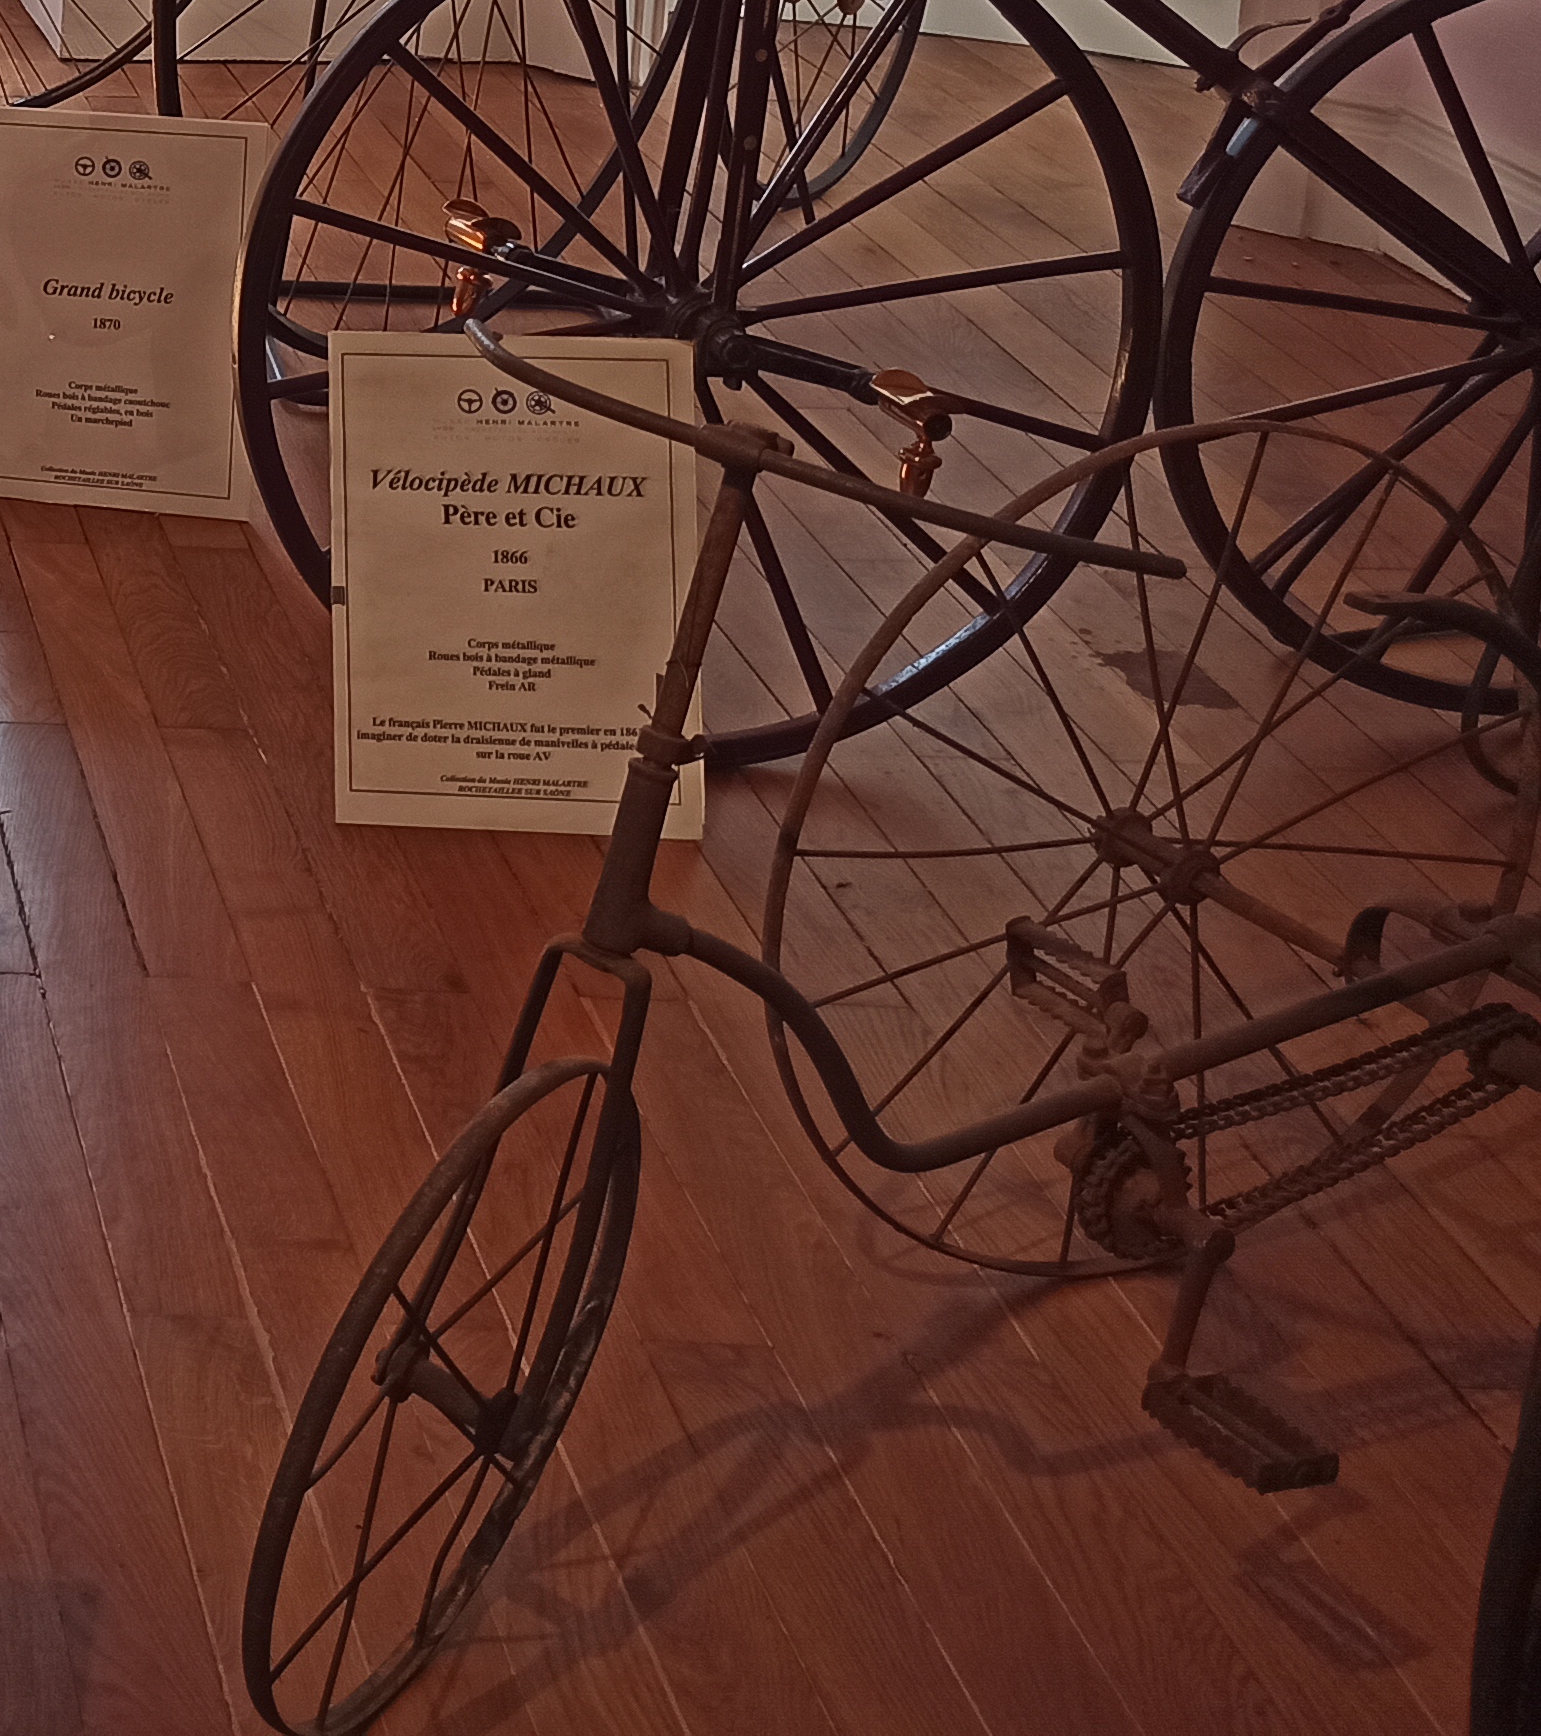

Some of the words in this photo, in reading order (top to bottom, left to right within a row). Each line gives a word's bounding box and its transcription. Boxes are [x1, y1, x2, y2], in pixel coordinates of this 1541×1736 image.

[42, 278, 104, 299] Grand
[107, 282, 173, 306] bicycle
[93, 317, 120, 330] 1870
[70, 413, 82, 422] Un
[517, 419, 579, 427] MALARTRE
[371, 468, 498, 497] Vélocipède
[505, 472, 647, 497] MICHAUX
[441, 503, 497, 526] Père
[504, 508, 527, 527] et
[534, 506, 575, 528] Cie
[493, 549, 527, 564] 1866
[483, 577, 537, 593] PARIS
[467, 637, 499, 651] Corps
[501, 639, 555, 653] métallique
[428, 650, 460, 661] Roues
[462, 651, 483, 662] bois
[485, 652, 492, 662] à
[494, 652, 538, 666] bandage
[540, 655, 595, 668] métallique
[472, 665, 511, 676] Pédales
[513, 668, 519, 677] à
[521, 663, 551, 679] gland
[488, 680, 515, 691] Frein
[518, 677, 536, 691] AR
[475, 751, 493, 759] sur
[494, 749, 504, 759] la
[507, 752, 531, 760] roue
[532, 751, 551, 761] AV
